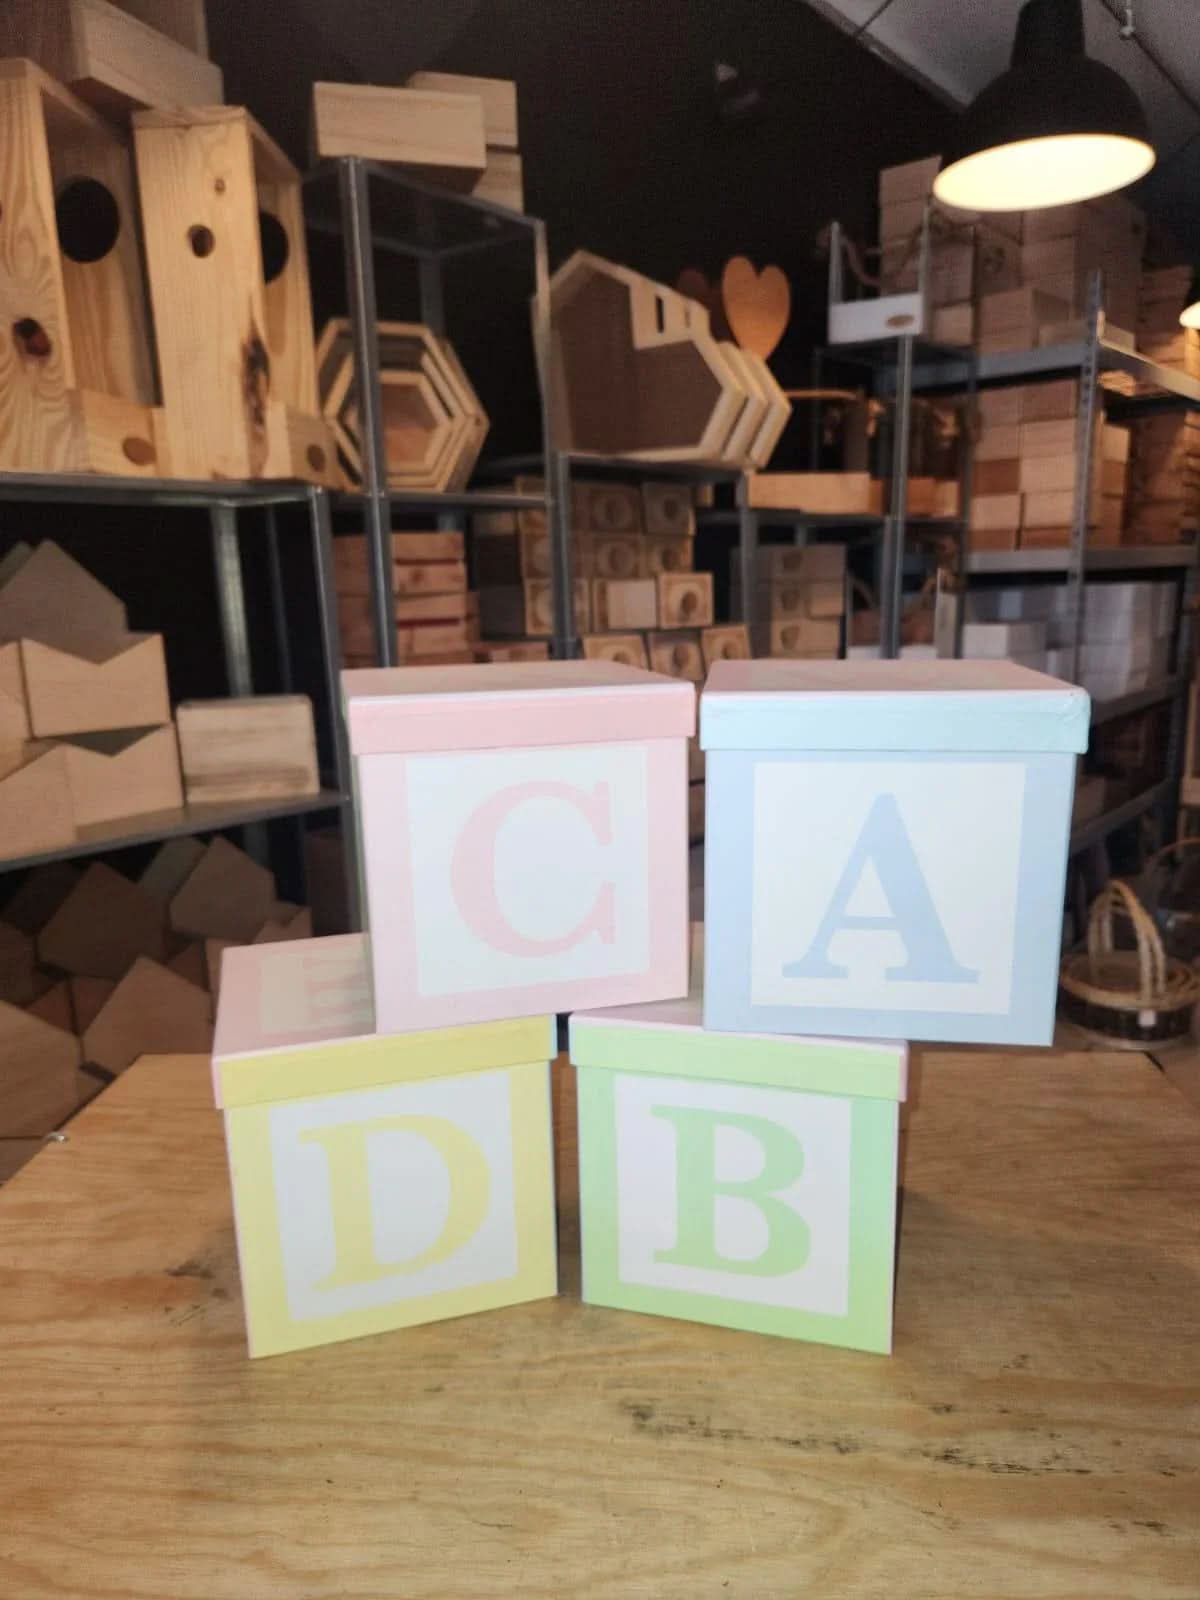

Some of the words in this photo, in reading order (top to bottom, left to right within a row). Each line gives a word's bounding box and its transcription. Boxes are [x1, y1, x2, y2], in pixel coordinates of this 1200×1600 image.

[451, 781, 616, 958] C
[782, 793, 979, 984] A
[298, 1114, 490, 1291] D
[651, 1104, 811, 1278] B
